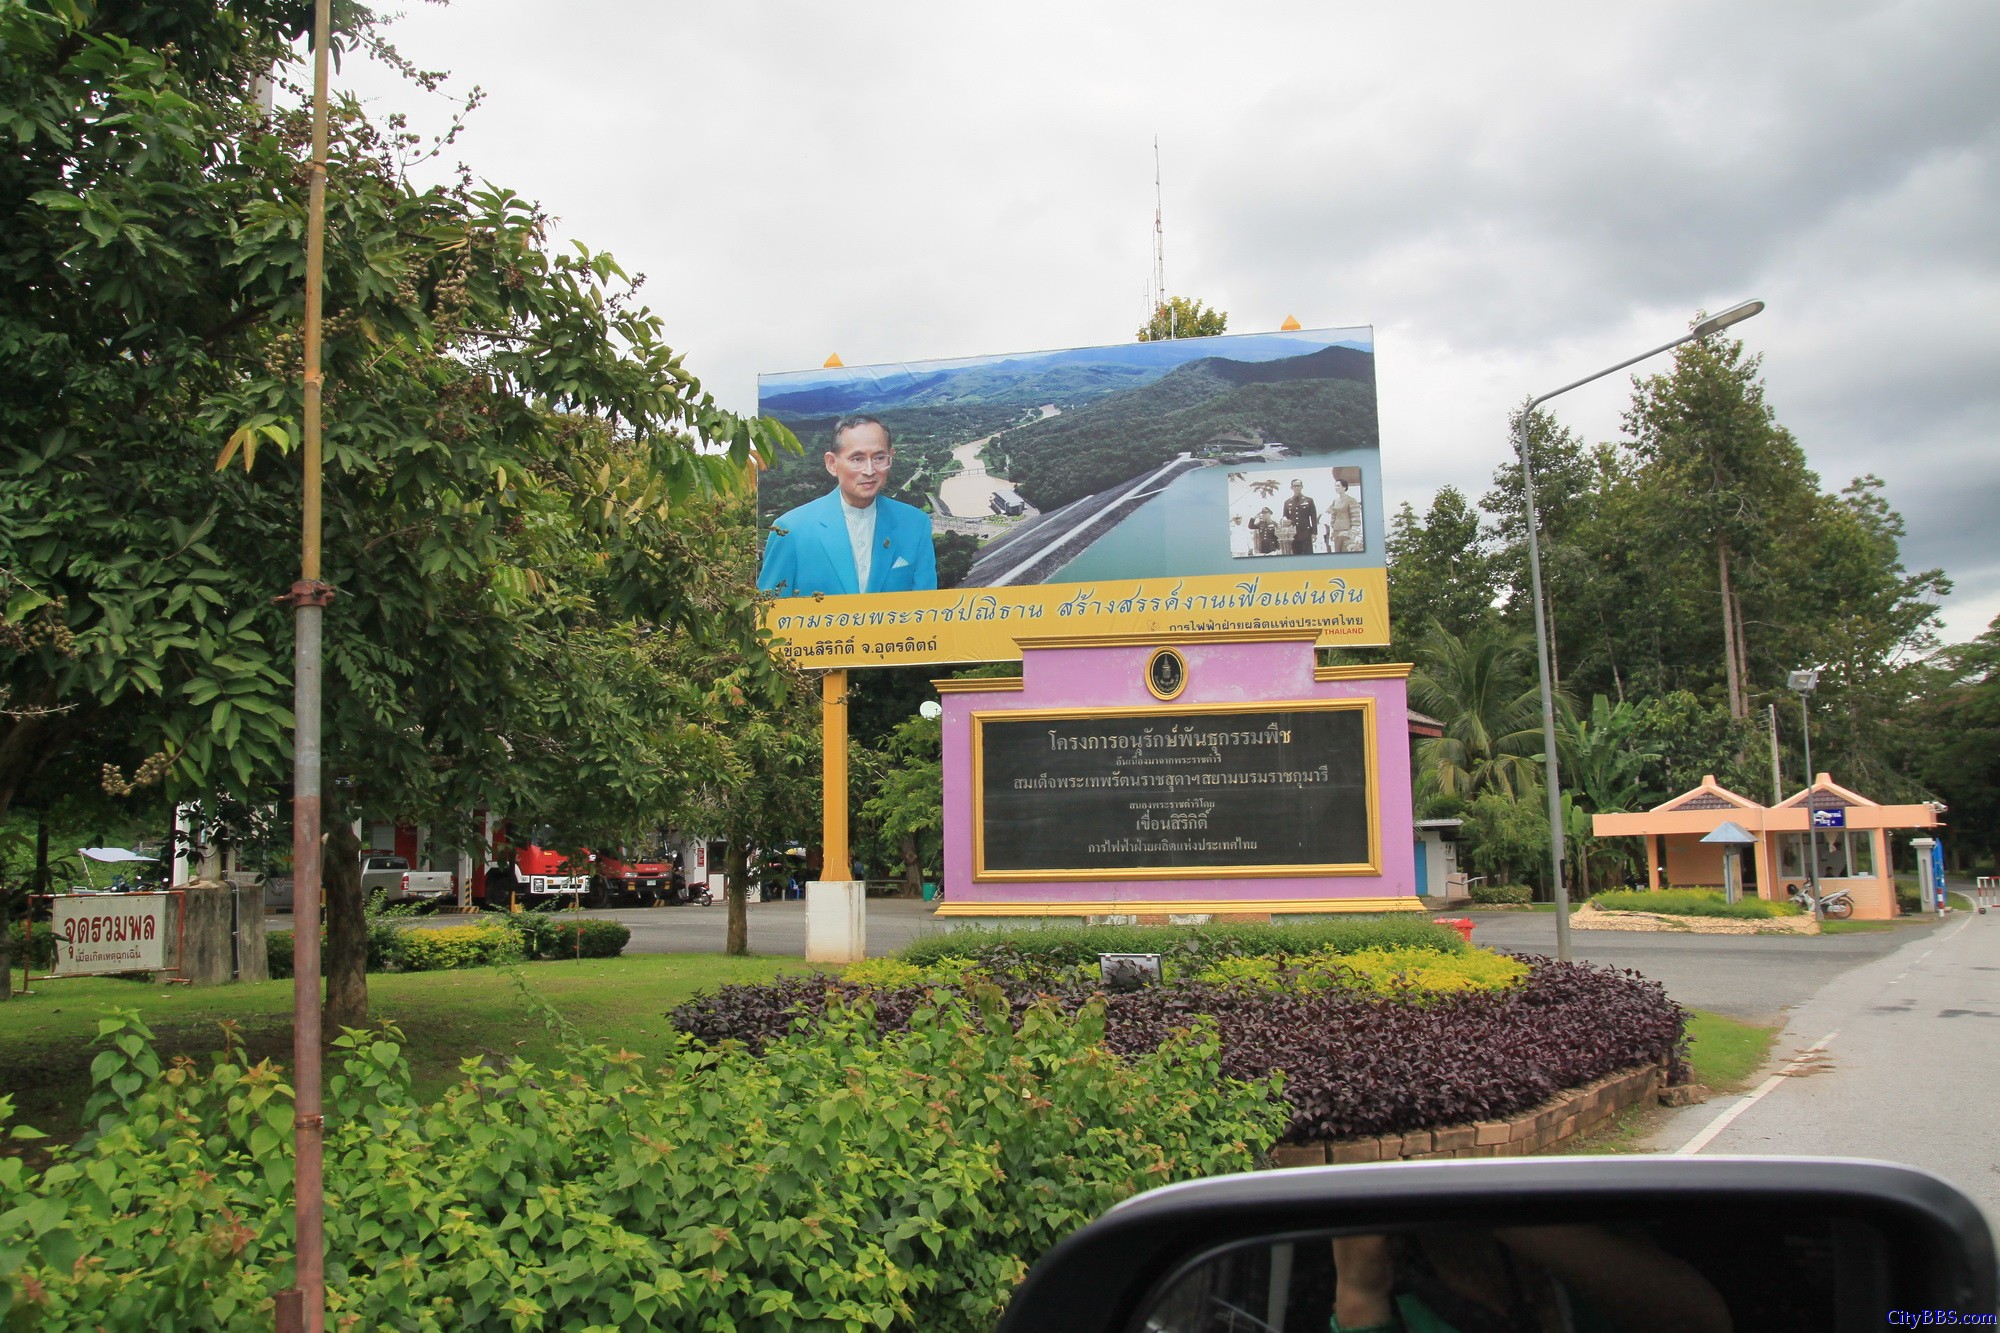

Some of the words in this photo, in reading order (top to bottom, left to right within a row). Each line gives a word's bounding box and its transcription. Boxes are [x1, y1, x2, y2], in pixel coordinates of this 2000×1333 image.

[777, 593, 1043, 630] ตามรอยพระราชปณิธาน
[1056, 576, 1364, 617] สร้างสรรค์งานเพื่อแผ่นดิน
[1323, 627, 1364, 635] THAILAND
[861, 635, 937, 659] จ.อุตรดิตถ์
[1048, 722, 1292, 756] โครงการอนุรักษ์พันธุกรรมพืช
[1136, 808, 1211, 831] เขื่อนสิริกิติ์
[64, 914, 155, 960] จุดรวมพล
